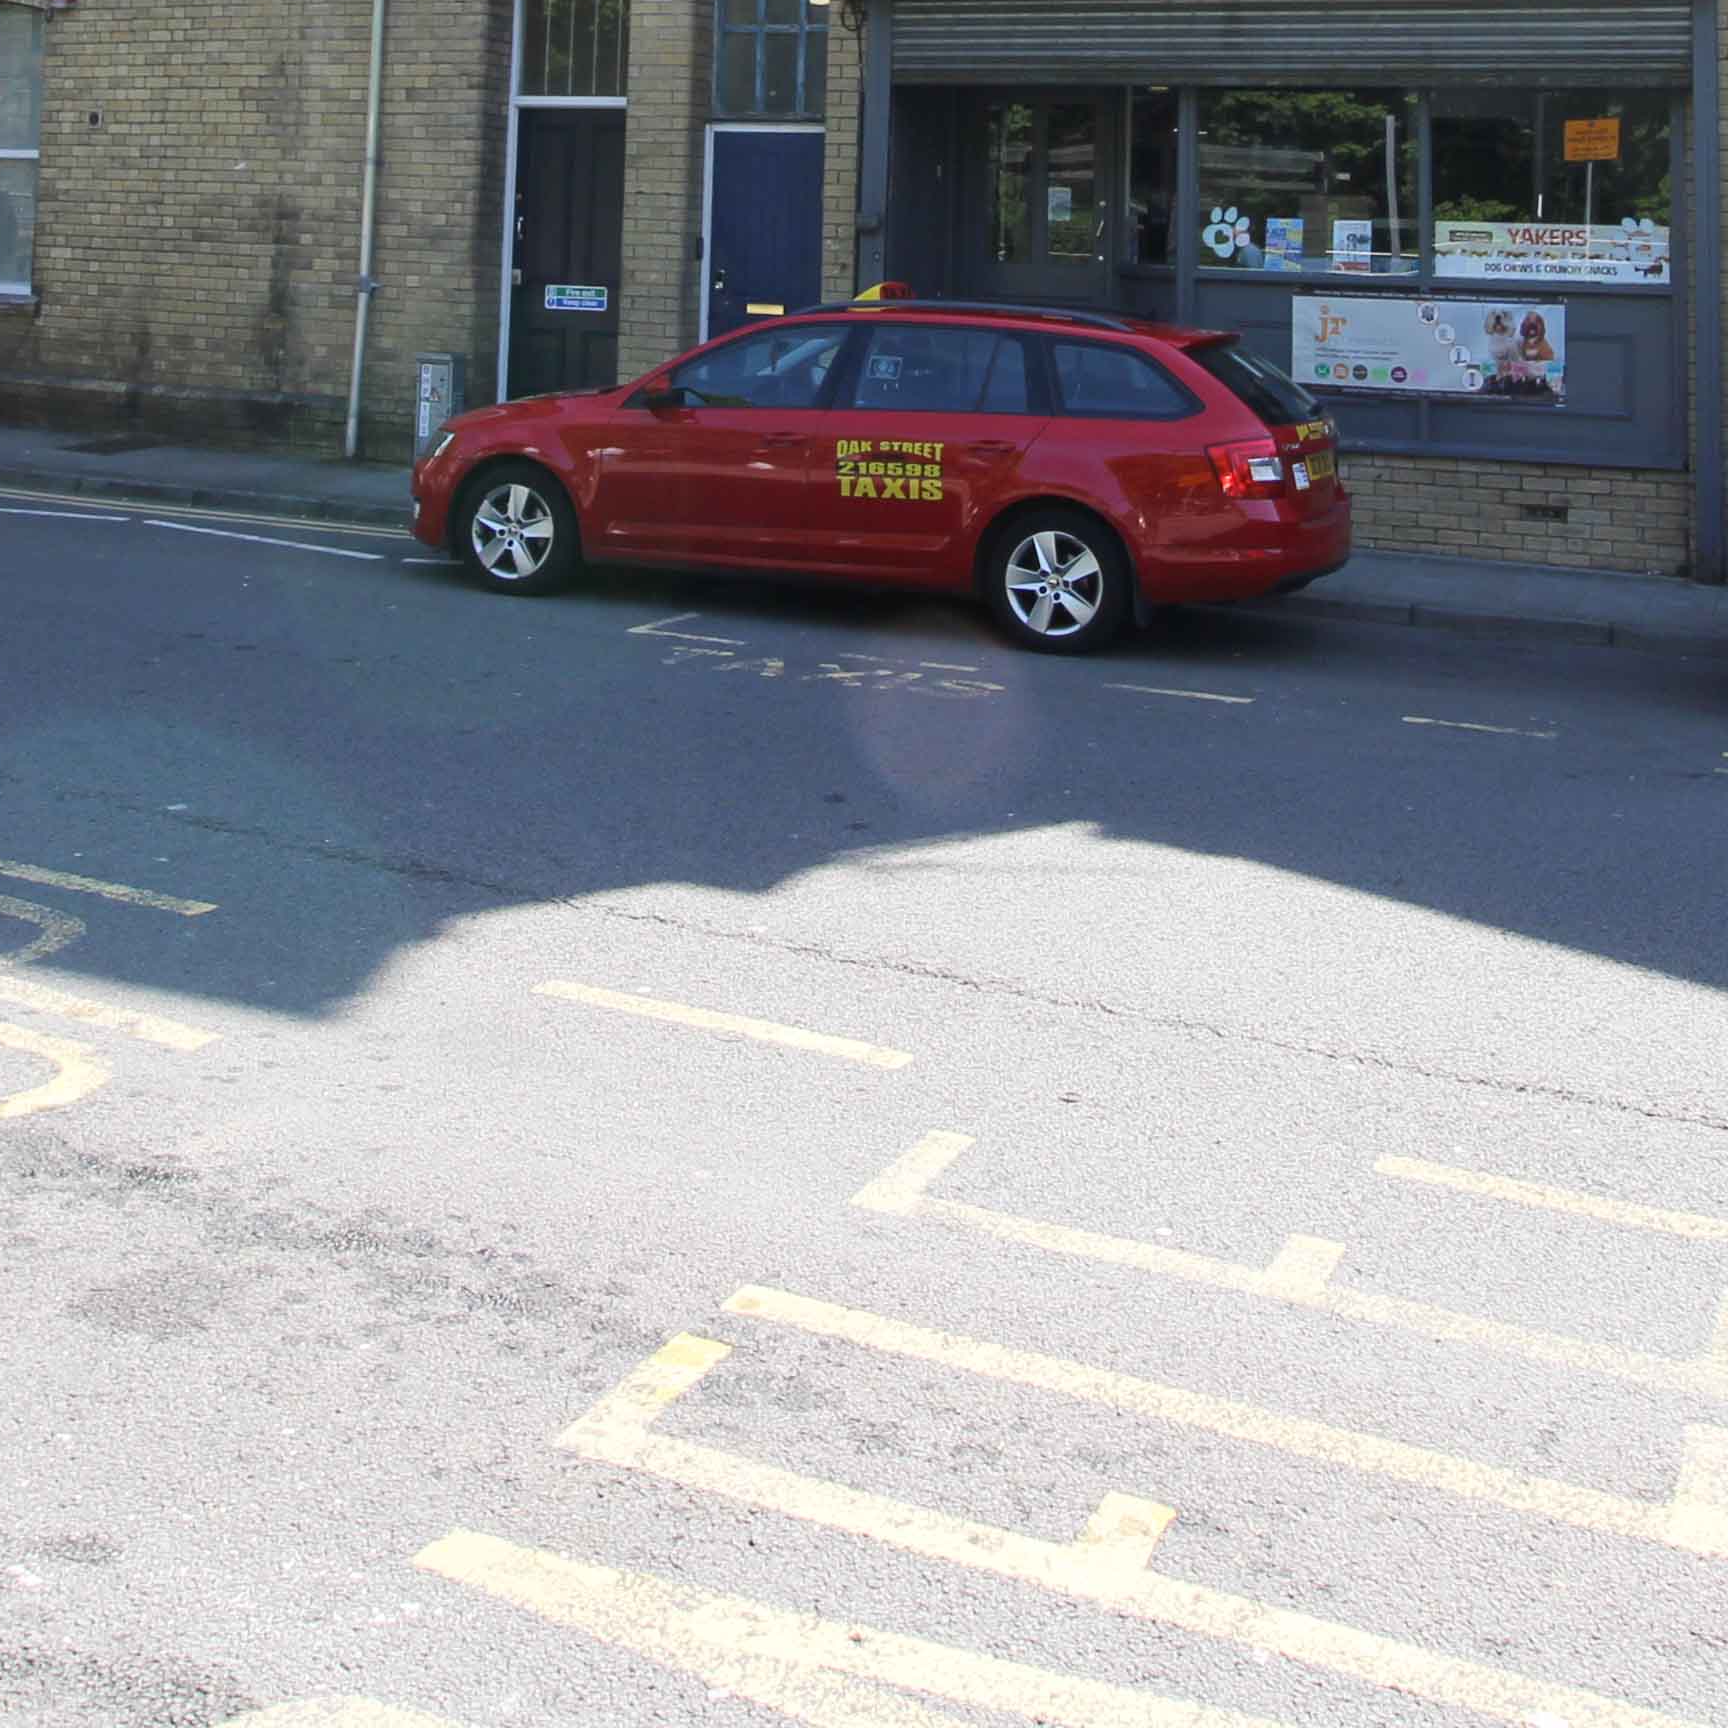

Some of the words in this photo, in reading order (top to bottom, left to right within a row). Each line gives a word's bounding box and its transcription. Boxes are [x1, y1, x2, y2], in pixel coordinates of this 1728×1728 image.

[1507, 228, 1588, 247] YAKERS
[1484, 263, 1502, 273] DOG
[836, 439, 872, 458] OAK
[879, 440, 945, 462] STREET
[836, 475, 944, 501] TAXIS
